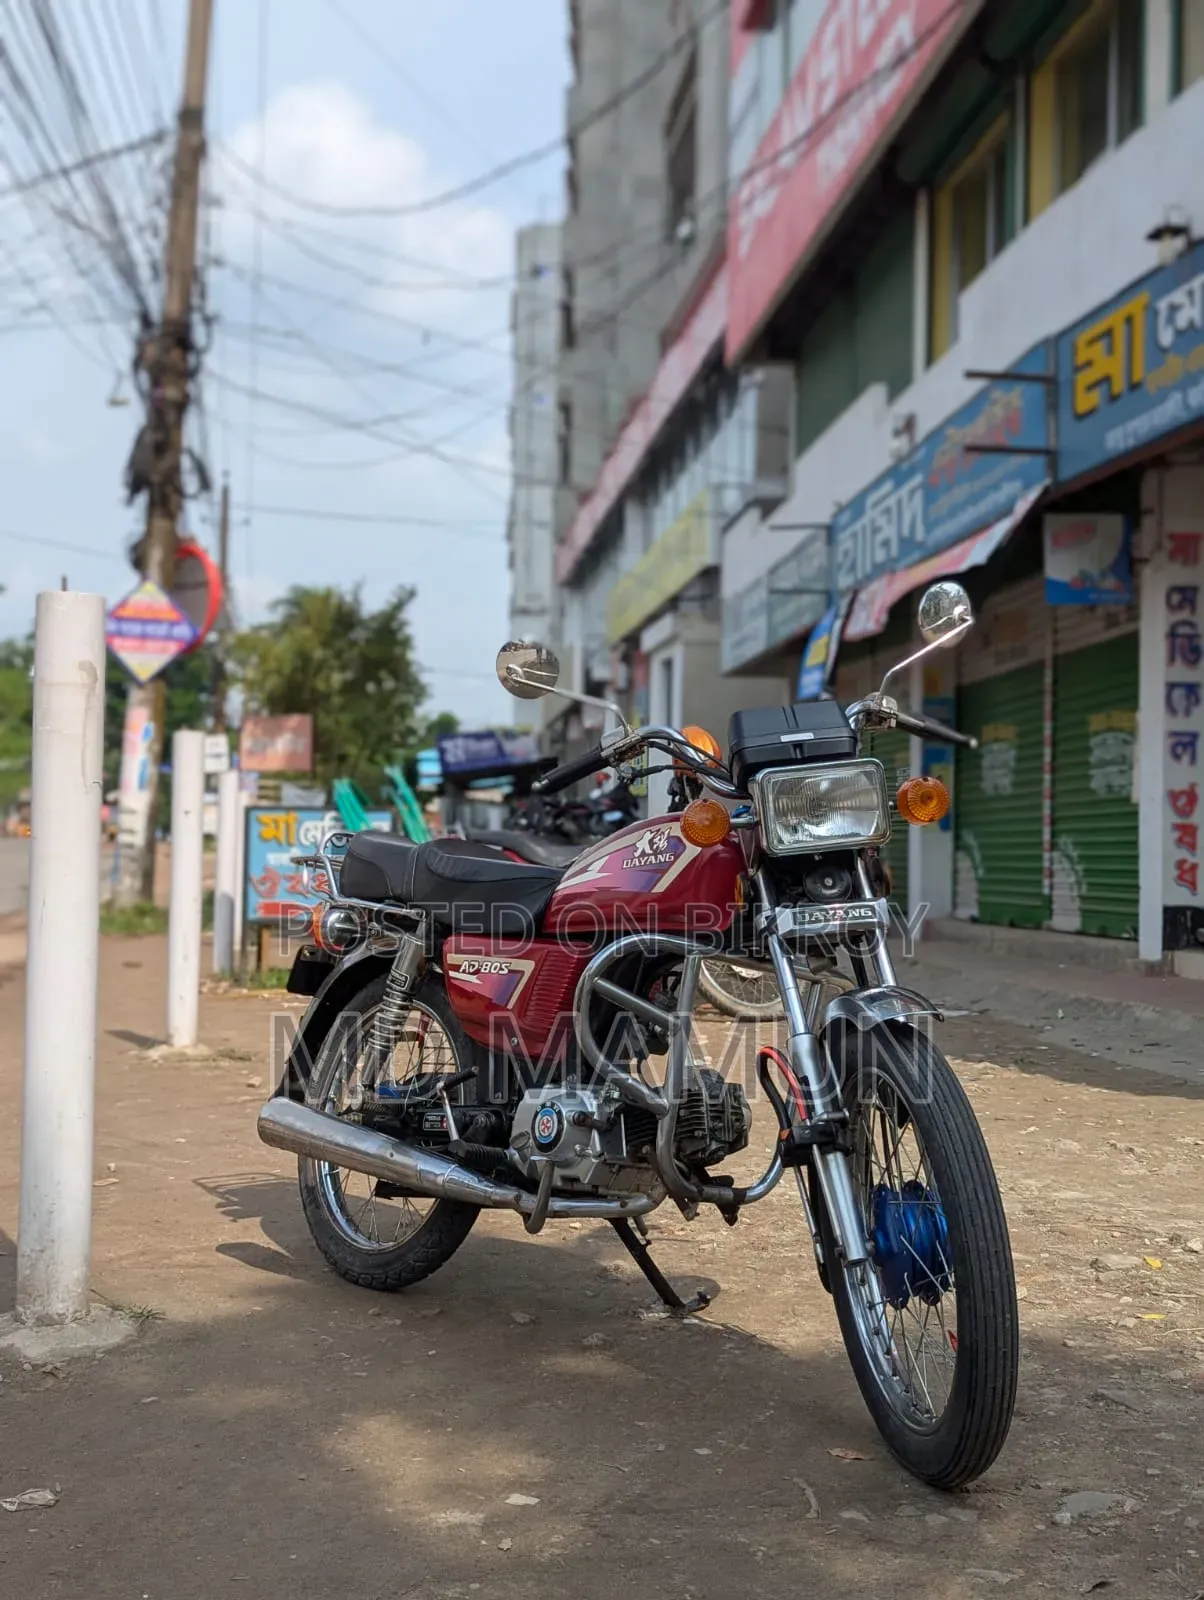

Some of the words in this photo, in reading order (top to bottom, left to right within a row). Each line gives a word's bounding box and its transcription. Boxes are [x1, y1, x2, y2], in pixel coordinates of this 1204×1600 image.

[257, 811, 297, 845] মা
[622, 853, 674, 868] DAYANG
[797, 907, 873, 922] DAYANG
